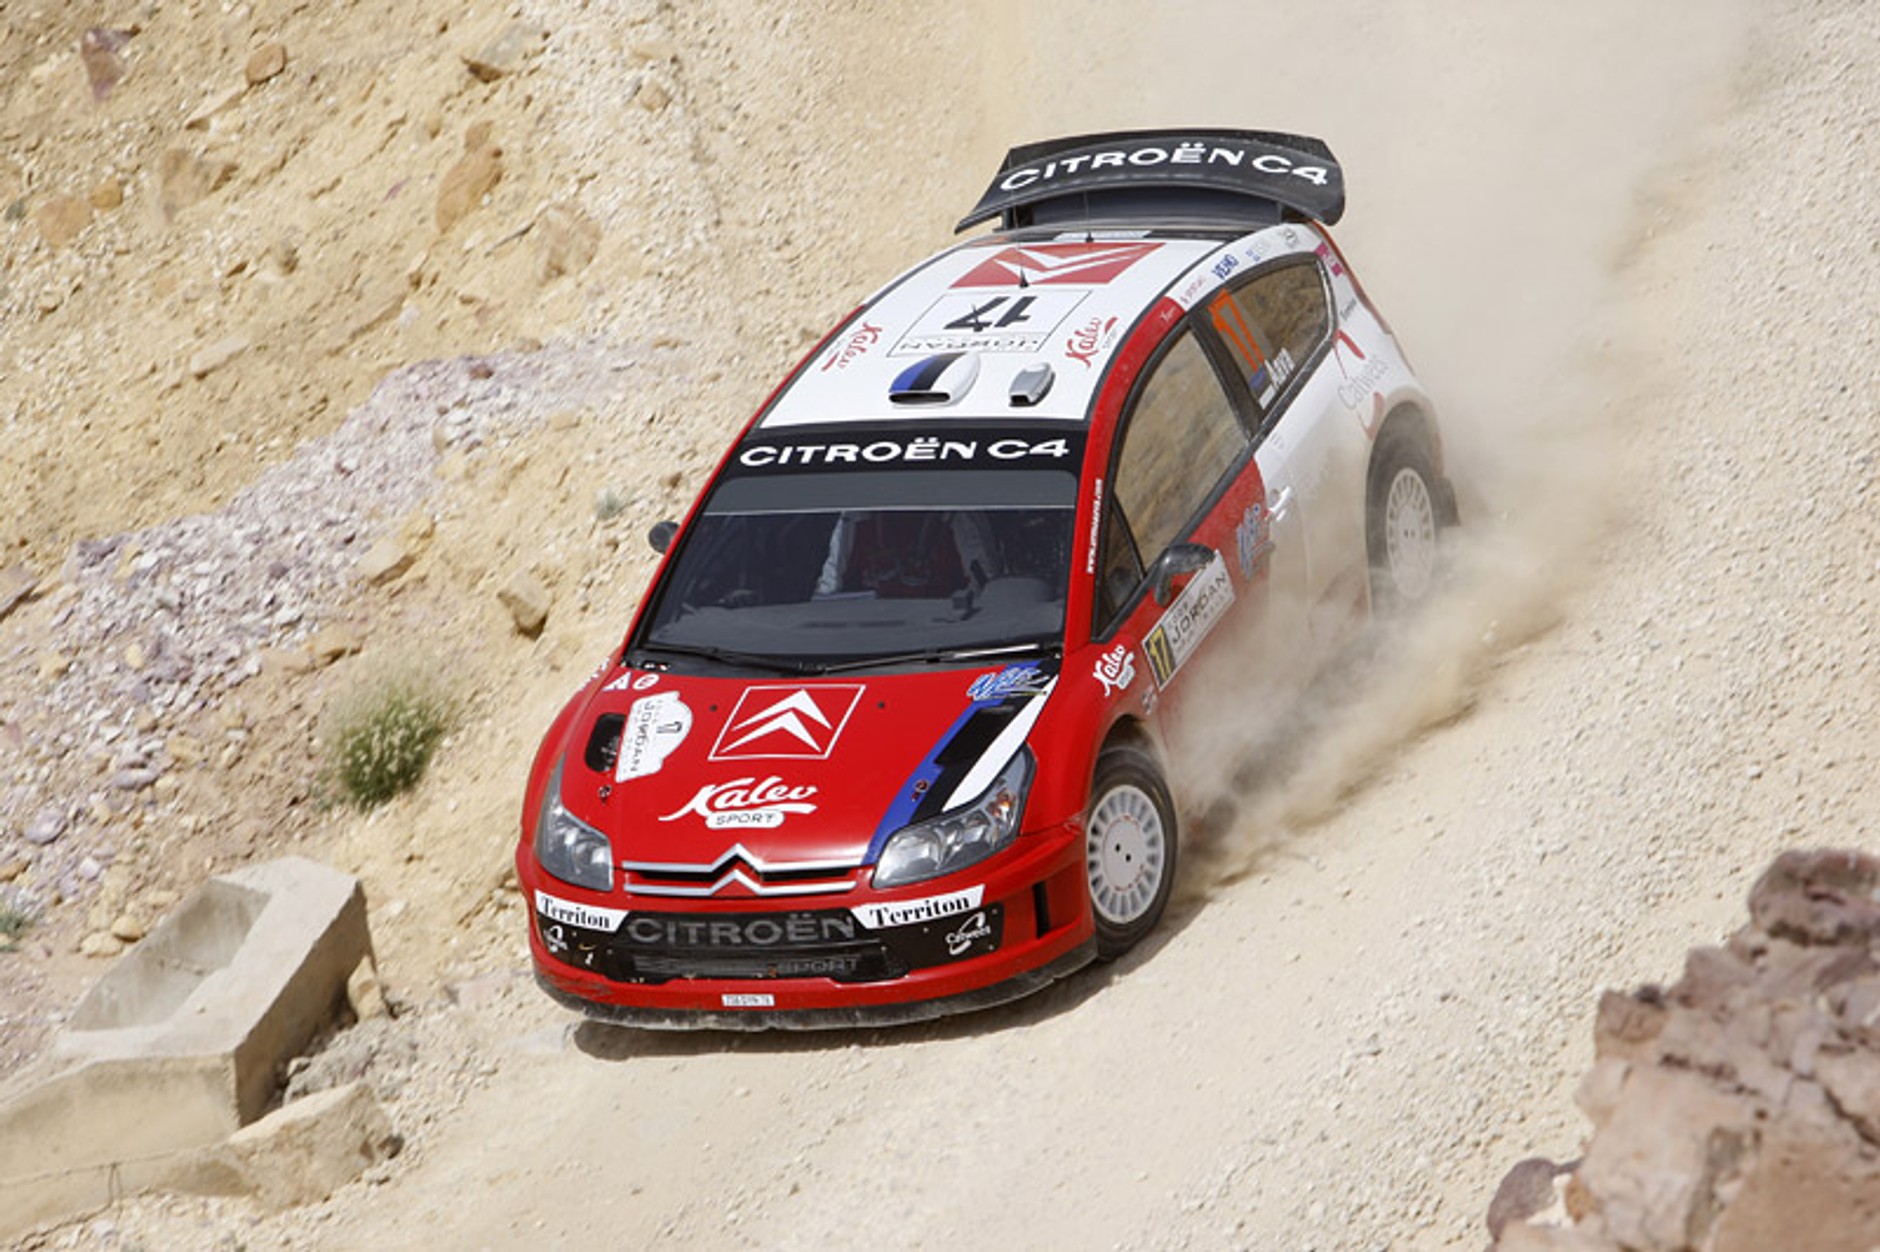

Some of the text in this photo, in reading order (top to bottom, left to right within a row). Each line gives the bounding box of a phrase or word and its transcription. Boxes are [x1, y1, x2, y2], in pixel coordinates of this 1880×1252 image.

[1000, 142, 1328, 191] CITROËN C4
[1208, 287, 1265, 373] 17
[739, 436, 1070, 467] CITROËN C4
[1171, 571, 1229, 645] JORDAN
[1149, 624, 1175, 688] 17
[658, 775, 818, 822] Kalev
[716, 812, 776, 826] SPORT
[541, 897, 611, 929] Territon
[626, 913, 855, 945] CITROËN
[869, 896, 970, 927] Territon
